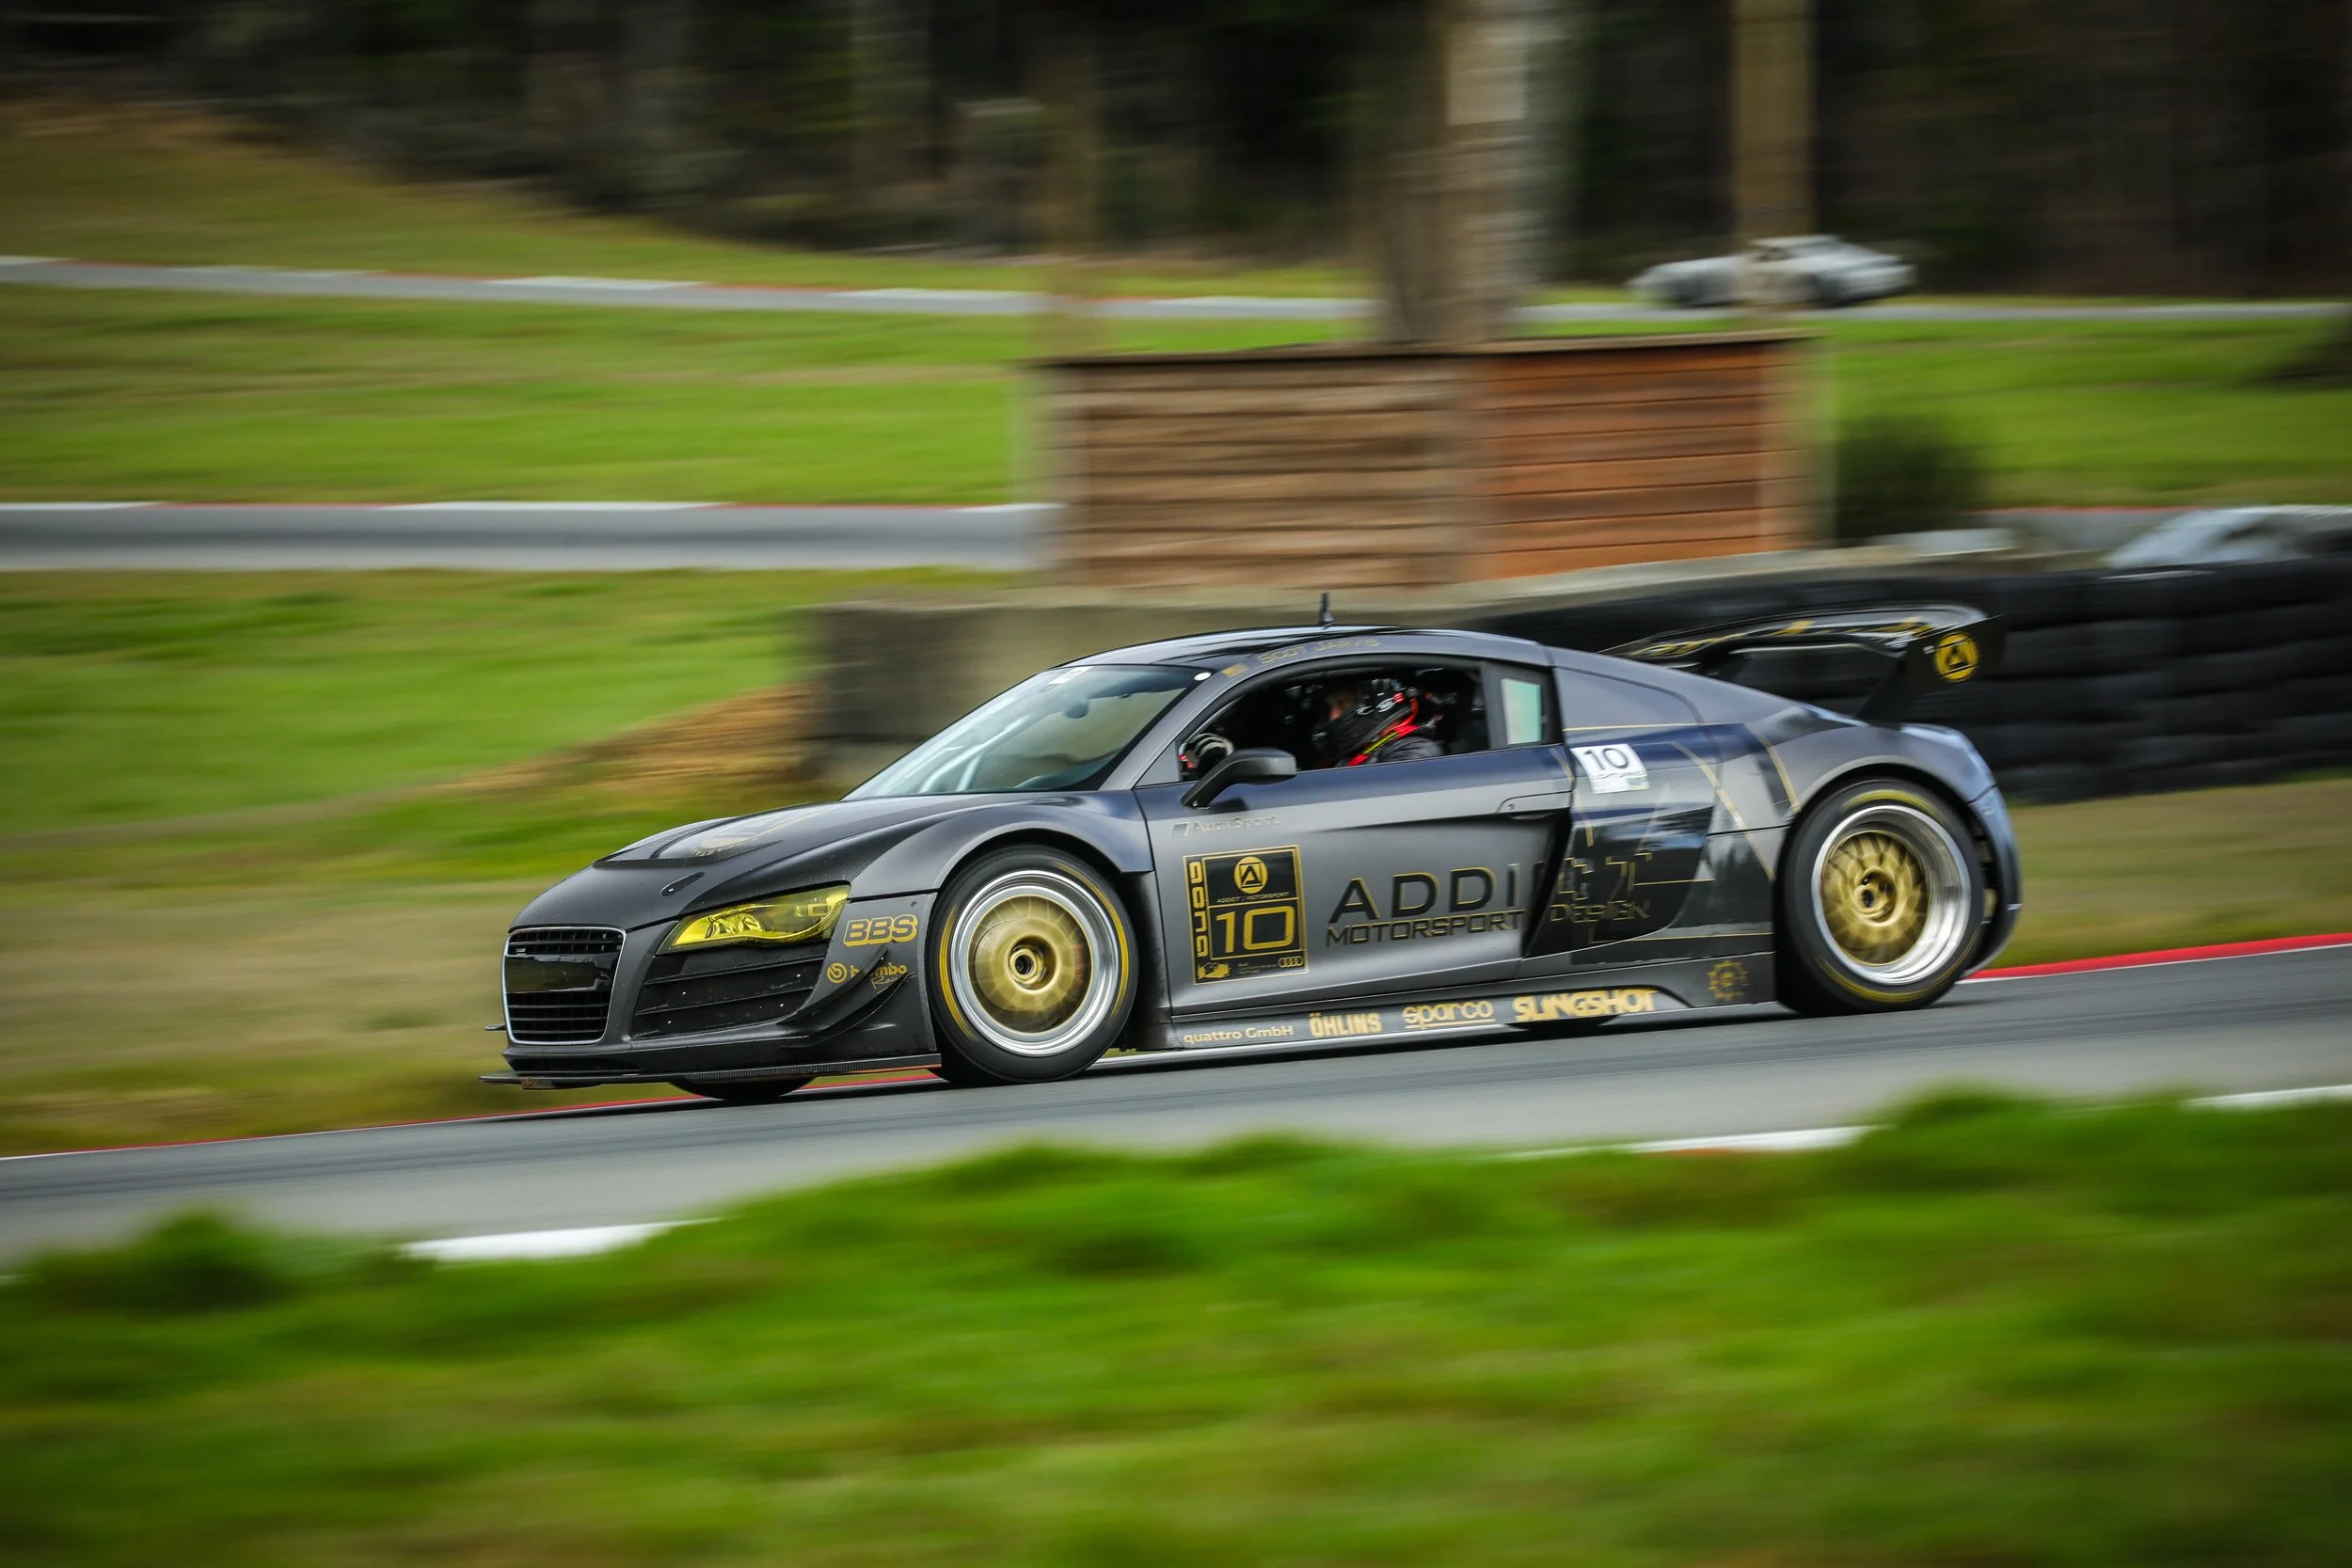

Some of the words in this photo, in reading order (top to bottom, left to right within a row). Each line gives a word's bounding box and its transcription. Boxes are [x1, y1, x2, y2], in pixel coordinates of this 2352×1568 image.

[1583, 747, 1629, 770] 10
[1194, 820, 1231, 832] Audi
[1233, 814, 1280, 831] Sport
[843, 913, 918, 947] BBS
[1216, 905, 1295, 953] 10
[1325, 909, 1527, 947] MOTORSPORT
[850, 962, 908, 979] bmbo
[1401, 1000, 1494, 1029] sparco
[1511, 989, 1659, 1022] SLINGSHOT
[1184, 1029, 1243, 1044] quattro
[1245, 1025, 1295, 1039] GmbH
[1309, 1012, 1383, 1037] ÖHLINS
